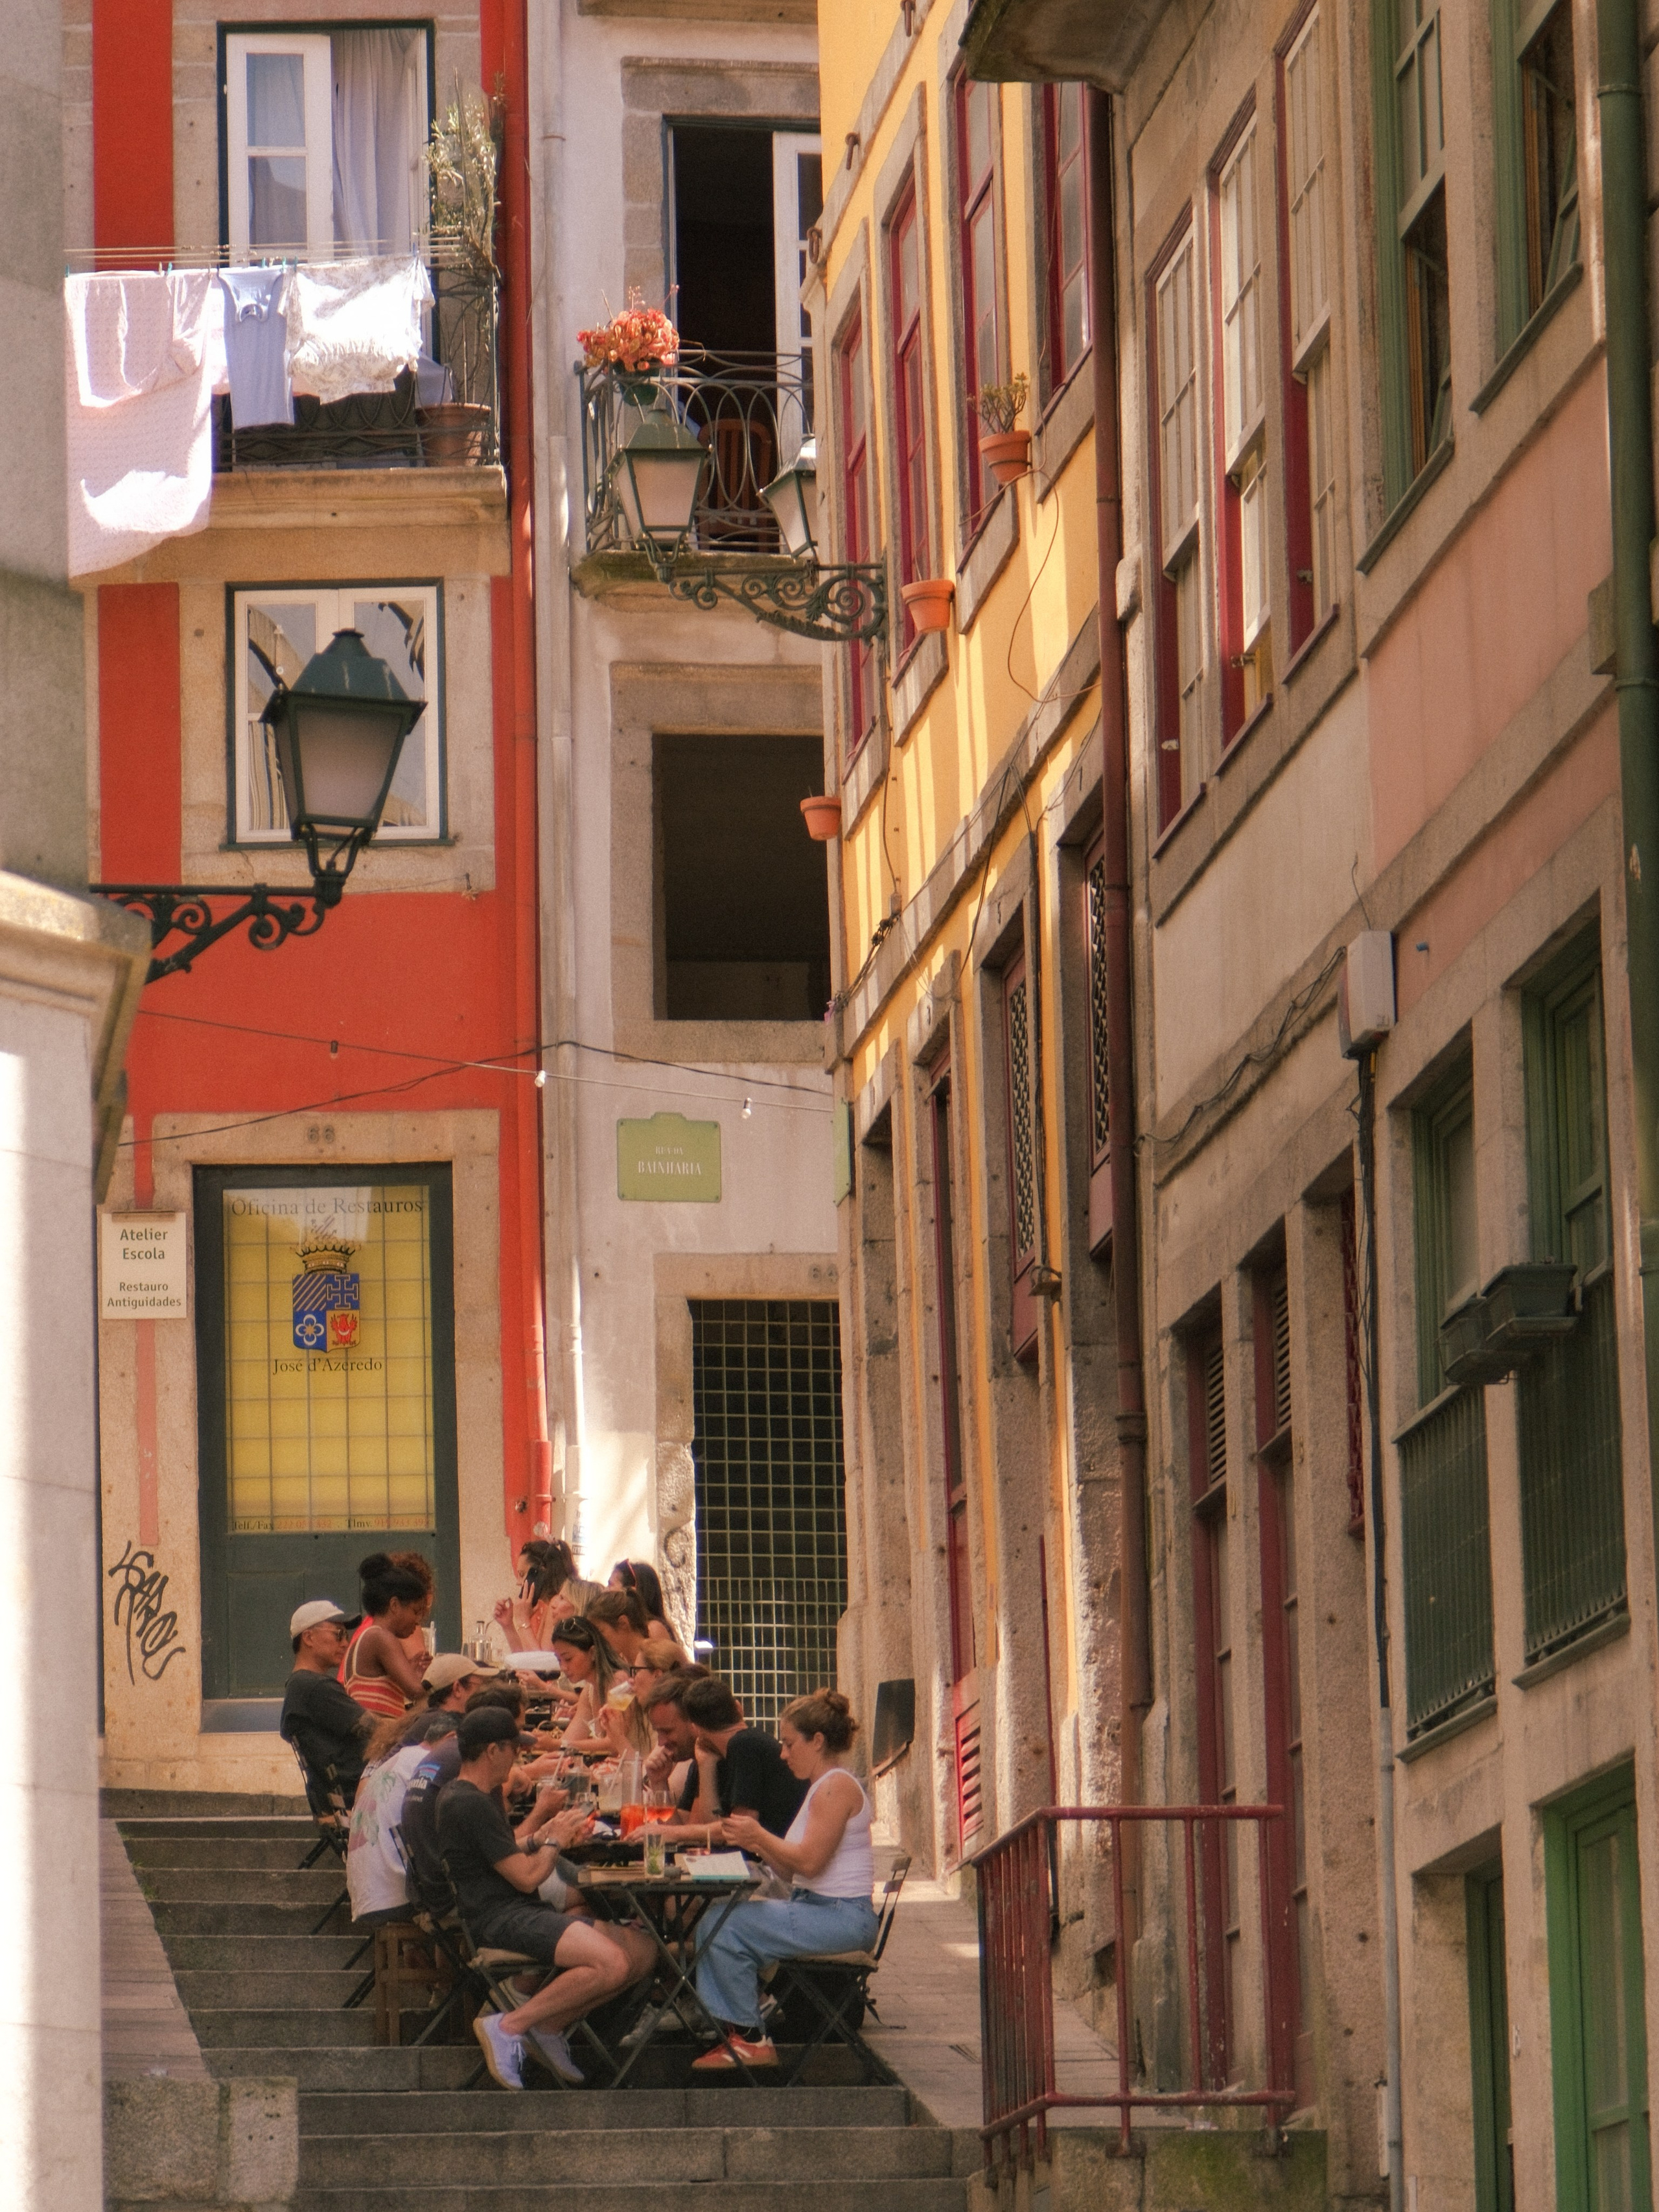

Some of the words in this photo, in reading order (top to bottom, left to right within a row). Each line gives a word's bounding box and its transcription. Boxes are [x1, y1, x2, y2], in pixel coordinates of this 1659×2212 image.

[655, 1146, 671, 1155] RUA
[673, 1147, 684, 1156] DA
[638, 1160, 702, 1175] BAINHARIA
[231, 1198, 299, 1216] Oficina
[305, 1197, 325, 1215] de
[334, 1196, 423, 1215] Restauros
[120, 1228, 168, 1241] Atelier
[122, 1247, 165, 1259] Escola
[119, 1282, 168, 1292] Restauro
[108, 1297, 181, 1310] Antiguidades
[273, 1359, 303, 1375] José
